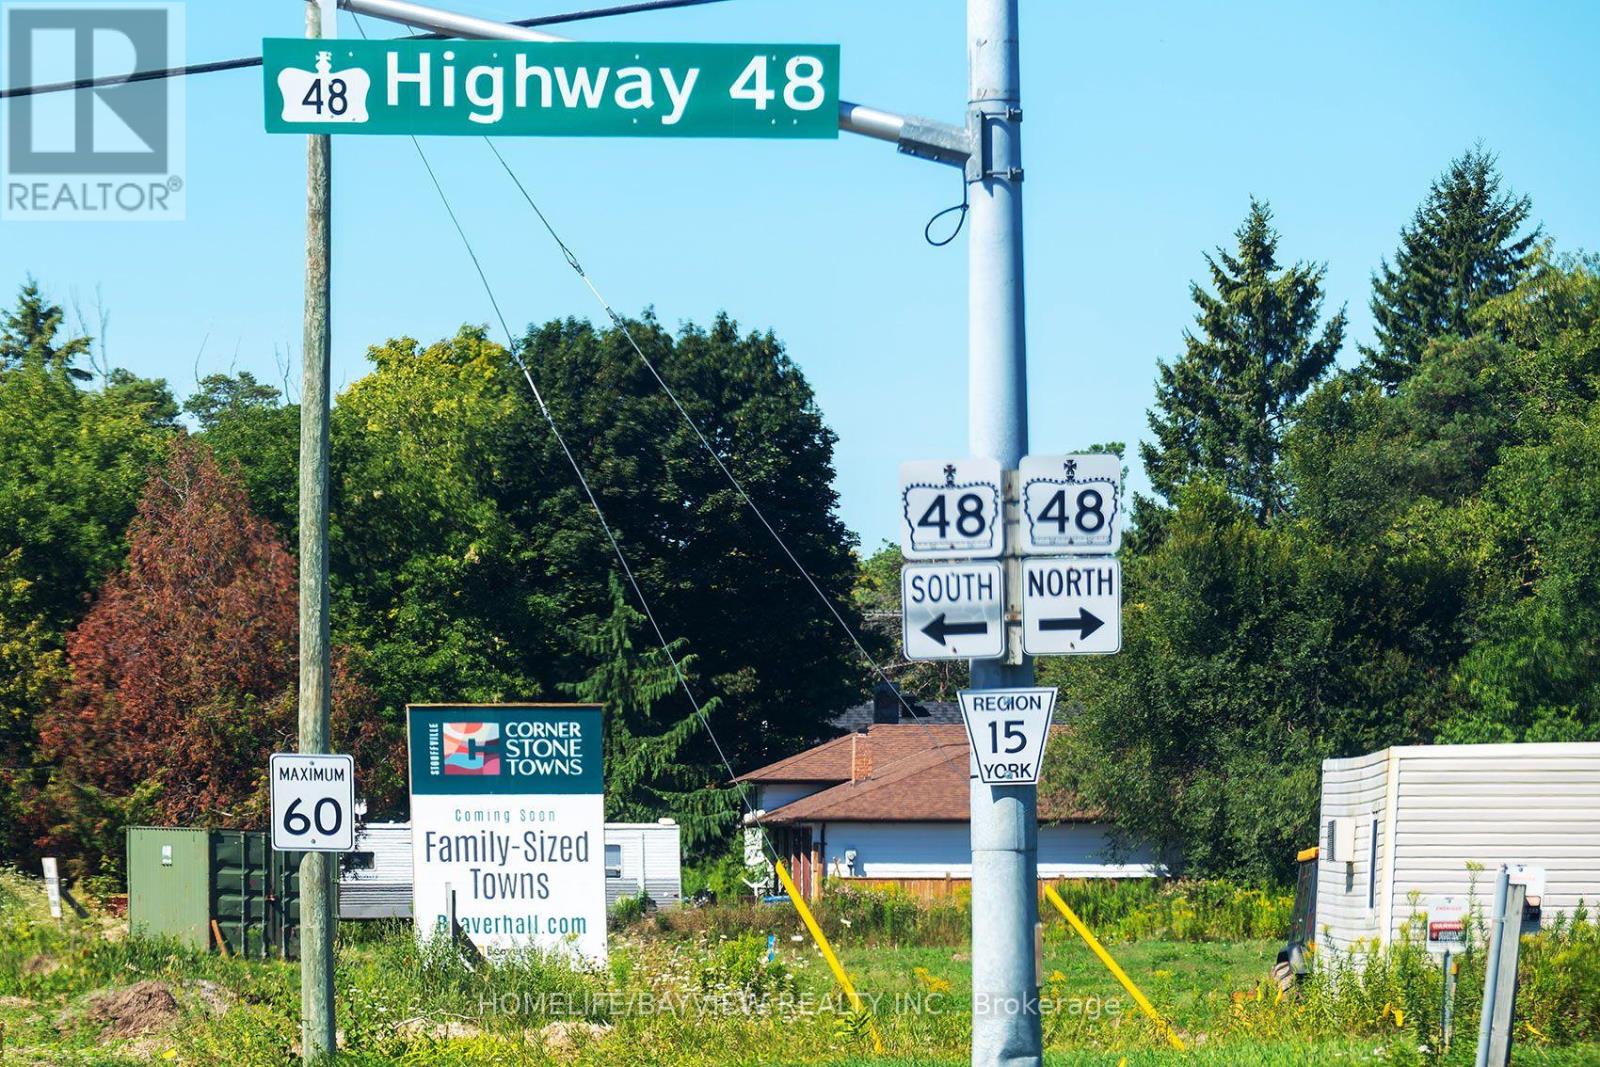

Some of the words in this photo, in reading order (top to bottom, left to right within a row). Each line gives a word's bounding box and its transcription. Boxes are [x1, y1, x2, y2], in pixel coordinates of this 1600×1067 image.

[301, 78, 348, 116] 48
[386, 51, 700, 125] Highway
[728, 54, 826, 111] 48
[917, 493, 986, 538] 48
[1036, 489, 1105, 533] 48
[911, 572, 993, 603] SOUTH
[1028, 568, 1113, 597] NORTH
[973, 695, 1042, 712] REGION
[504, 721, 582, 738] CORNER
[988, 720, 1027, 754] 15
[505, 738, 583, 758] STONE
[279, 767, 345, 782] MAXIMUM
[505, 758, 583, 776] TOWNS
[984, 763, 1032, 779] YORK
[283, 797, 343, 836] 60
[455, 808, 510, 823] Coming
[519, 808, 556, 822] Soon
[425, 830, 589, 866] Family-Sized
[470, 868, 550, 900] Towns
[437, 914, 587, 934] Baverhall.com
